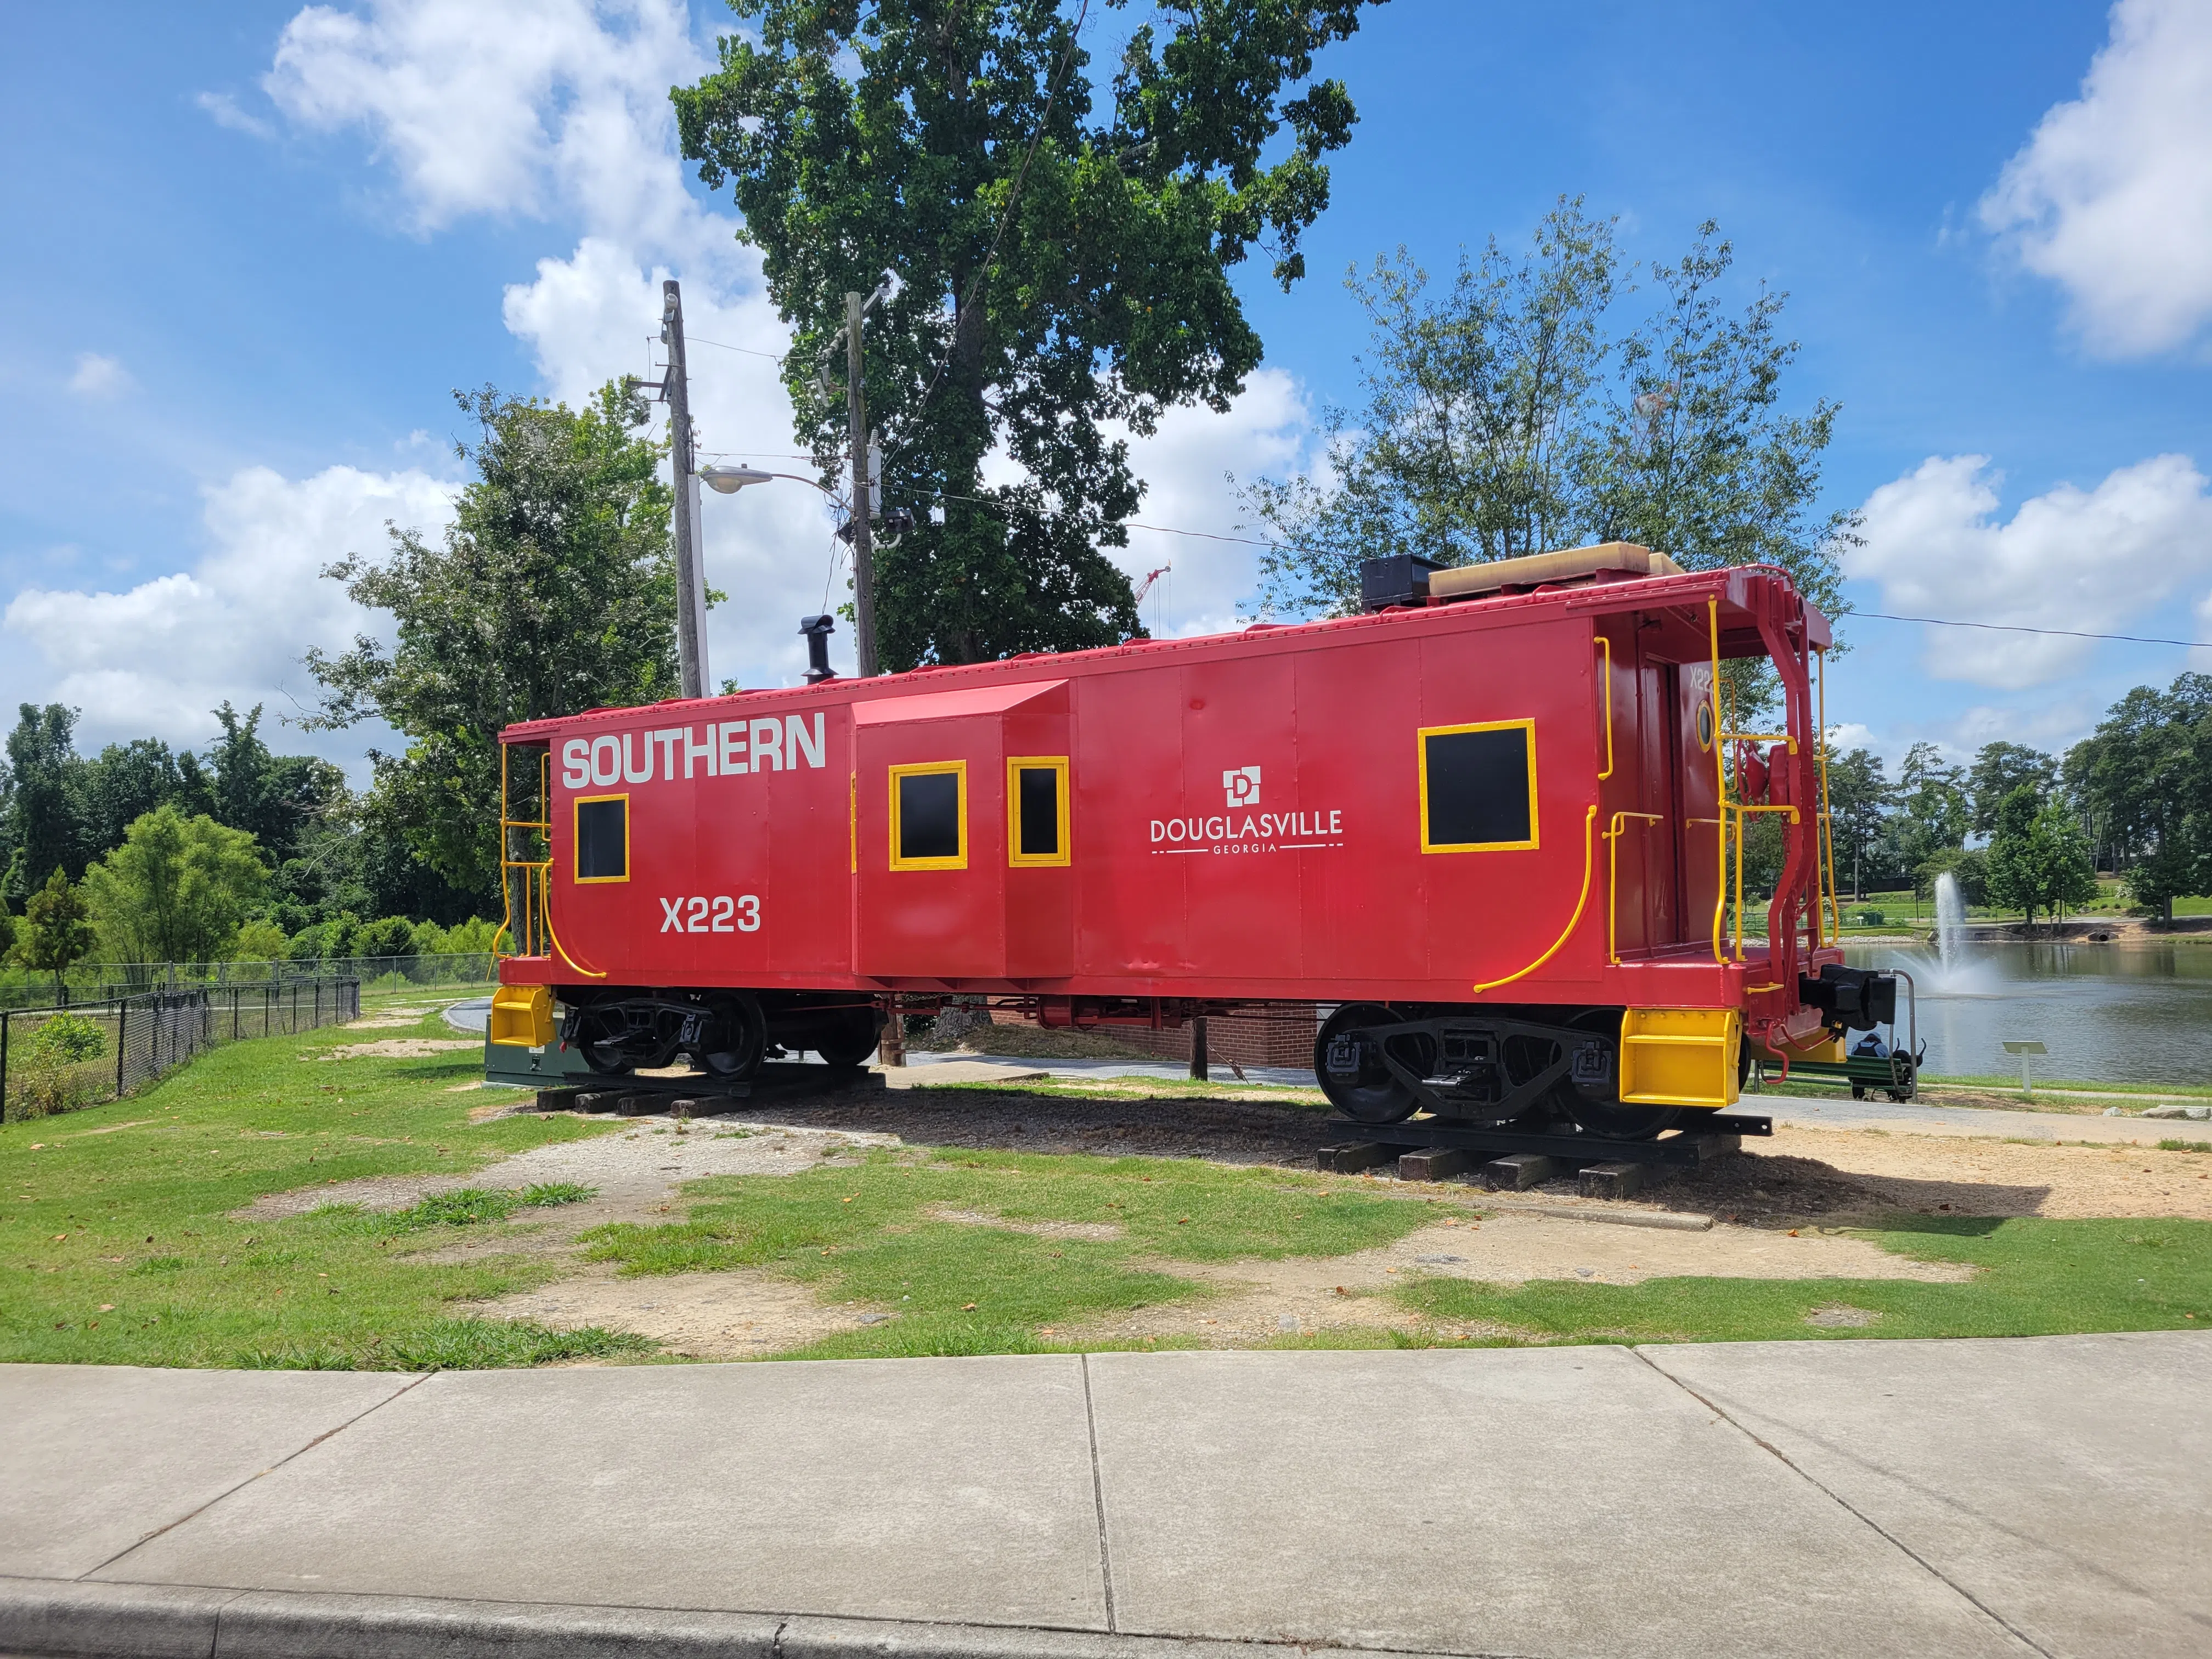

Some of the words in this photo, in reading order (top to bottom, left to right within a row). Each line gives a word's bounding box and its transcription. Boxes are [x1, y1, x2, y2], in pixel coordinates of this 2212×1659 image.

[562, 712, 826, 789] SOUTHERN
[1150, 810, 1342, 842] DOUGLASVILLE
[1213, 843, 1277, 854] GEORGIA
[659, 894, 760, 933] X223
